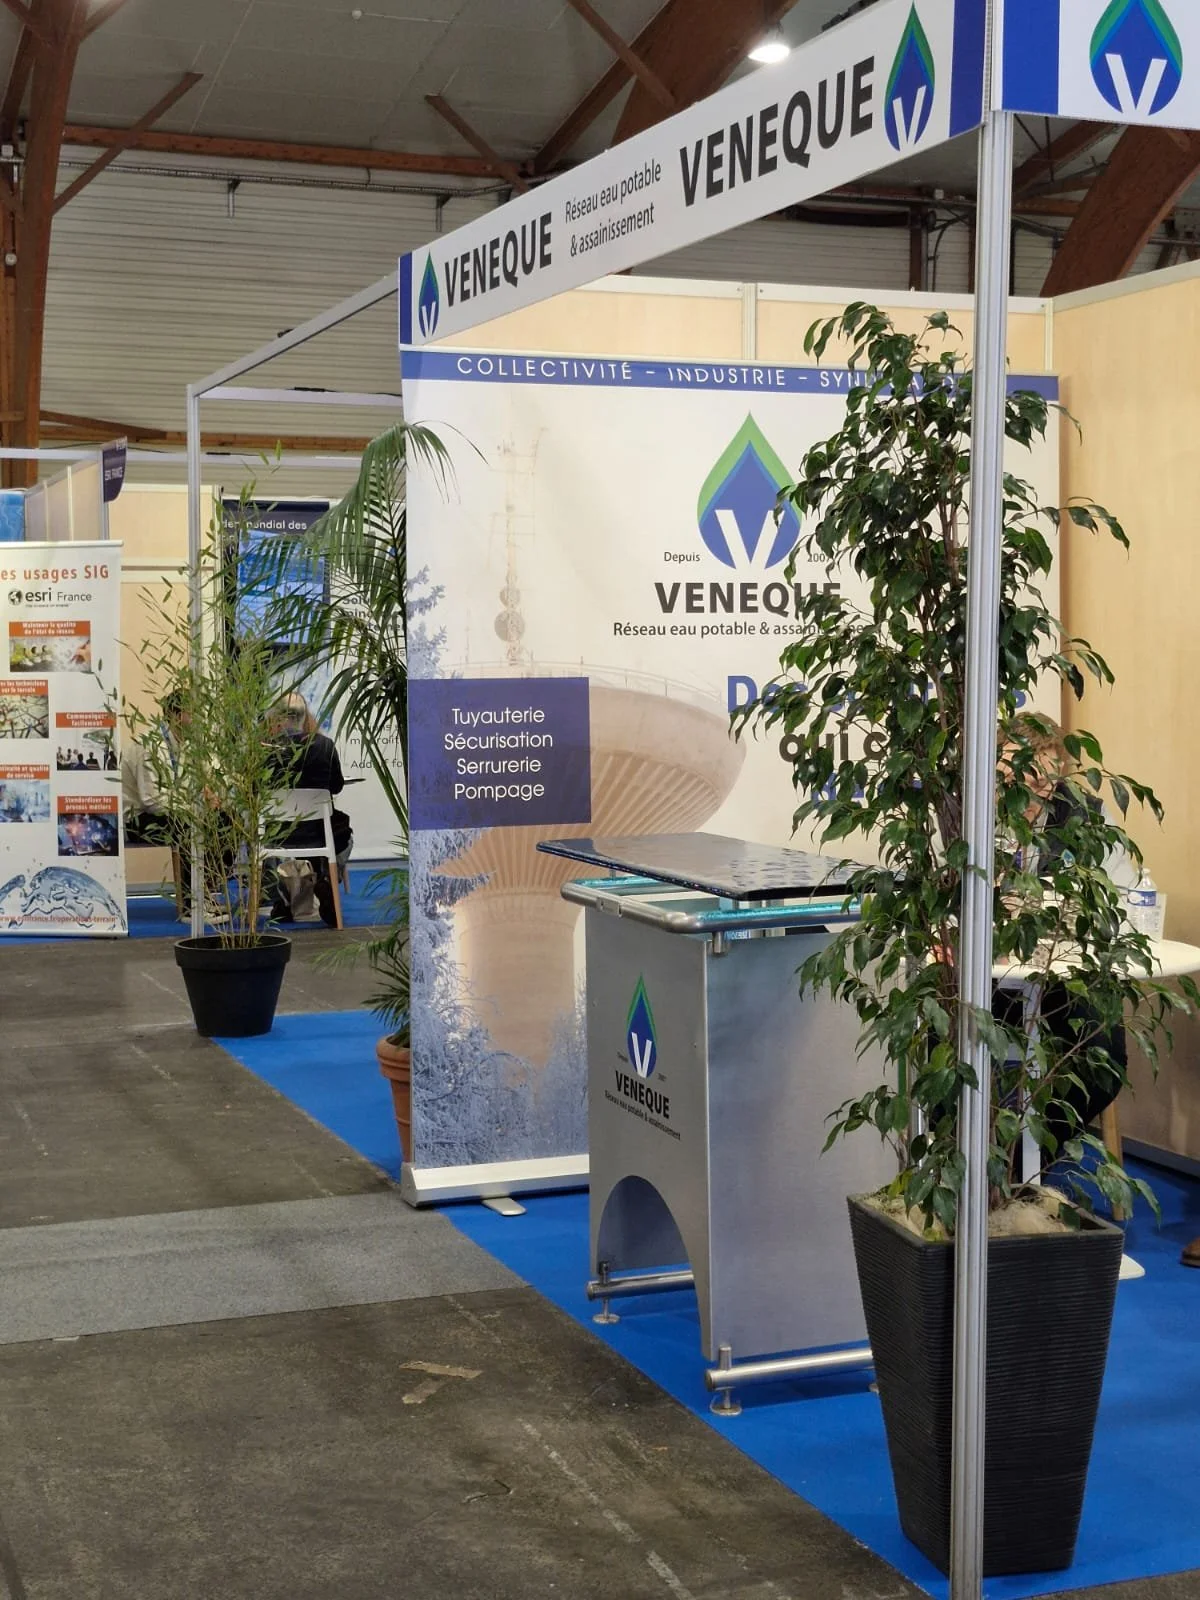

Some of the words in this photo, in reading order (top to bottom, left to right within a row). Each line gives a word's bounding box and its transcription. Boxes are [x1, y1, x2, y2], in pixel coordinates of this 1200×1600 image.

[680, 56, 875, 207] VENEQUE
[565, 193, 598, 224] Réseau
[600, 184, 618, 207] eau
[621, 159, 661, 205] potable
[570, 234, 577, 257] &
[580, 202, 655, 254] assainissement
[444, 212, 552, 308] VENEQUE
[457, 357, 632, 380] COLLECTIVITÉ
[667, 367, 786, 386] INDUSTRIE
[288, 520, 307, 530] des
[664, 552, 701, 564] Depuis
[24, 568, 77, 583] usages
[84, 565, 109, 579] SIG
[25, 587, 52, 602] esri
[57, 591, 92, 602] France
[613, 622, 666, 636] Réseau
[670, 625, 700, 636] eau
[700, 621, 756, 639] potable
[759, 622, 769, 635] &
[452, 706, 545, 728] Tuyauterie
[444, 731, 553, 750] Sécurisation
[457, 756, 541, 775] Serrurerie
[454, 783, 545, 802] Pompage
[615, 1070, 670, 1119] VENEQUE
